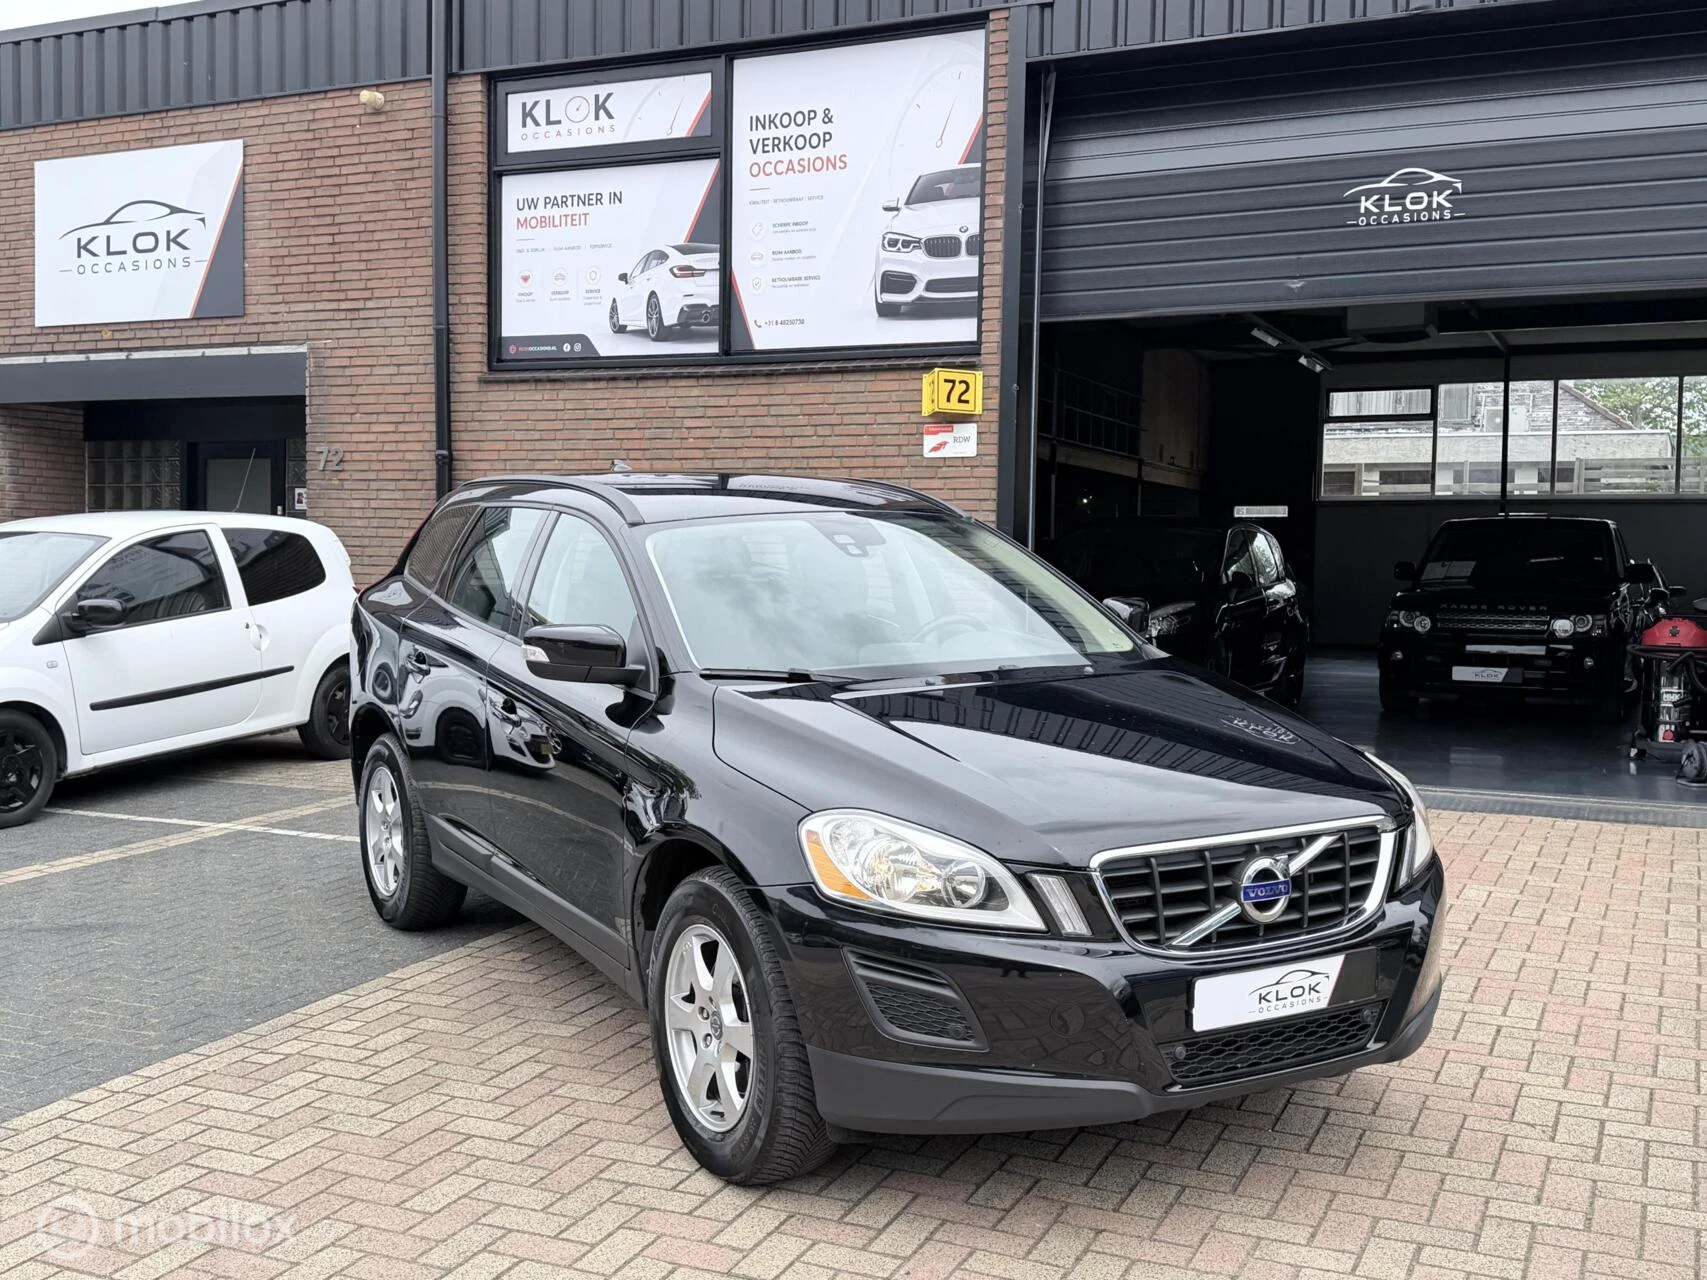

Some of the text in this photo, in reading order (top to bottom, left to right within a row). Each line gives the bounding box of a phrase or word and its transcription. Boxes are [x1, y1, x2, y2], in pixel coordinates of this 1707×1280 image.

[521, 92, 615, 128] KLOK
[750, 108, 834, 131] INKOOP &
[521, 124, 615, 141] OCCASIONS
[749, 131, 833, 155] VERKOOP
[749, 154, 848, 178] OCCASIONS
[516, 190, 623, 211] UW PARTNER IN
[1360, 189, 1453, 214] KLOK
[516, 212, 590, 230] MOBILITEIT
[1358, 210, 1451, 226] OCCASIONS
[76, 228, 191, 259] KLOK
[76, 257, 191, 275] OCCASIONS
[943, 378, 970, 405] 72
[953, 435, 971, 444] RDW
[316, 446, 345, 472] 72
[1246, 884, 1288, 898] VOLVO
[1258, 981, 1322, 1005] KLOK
[1258, 996, 1322, 1014] OCCASIONS
